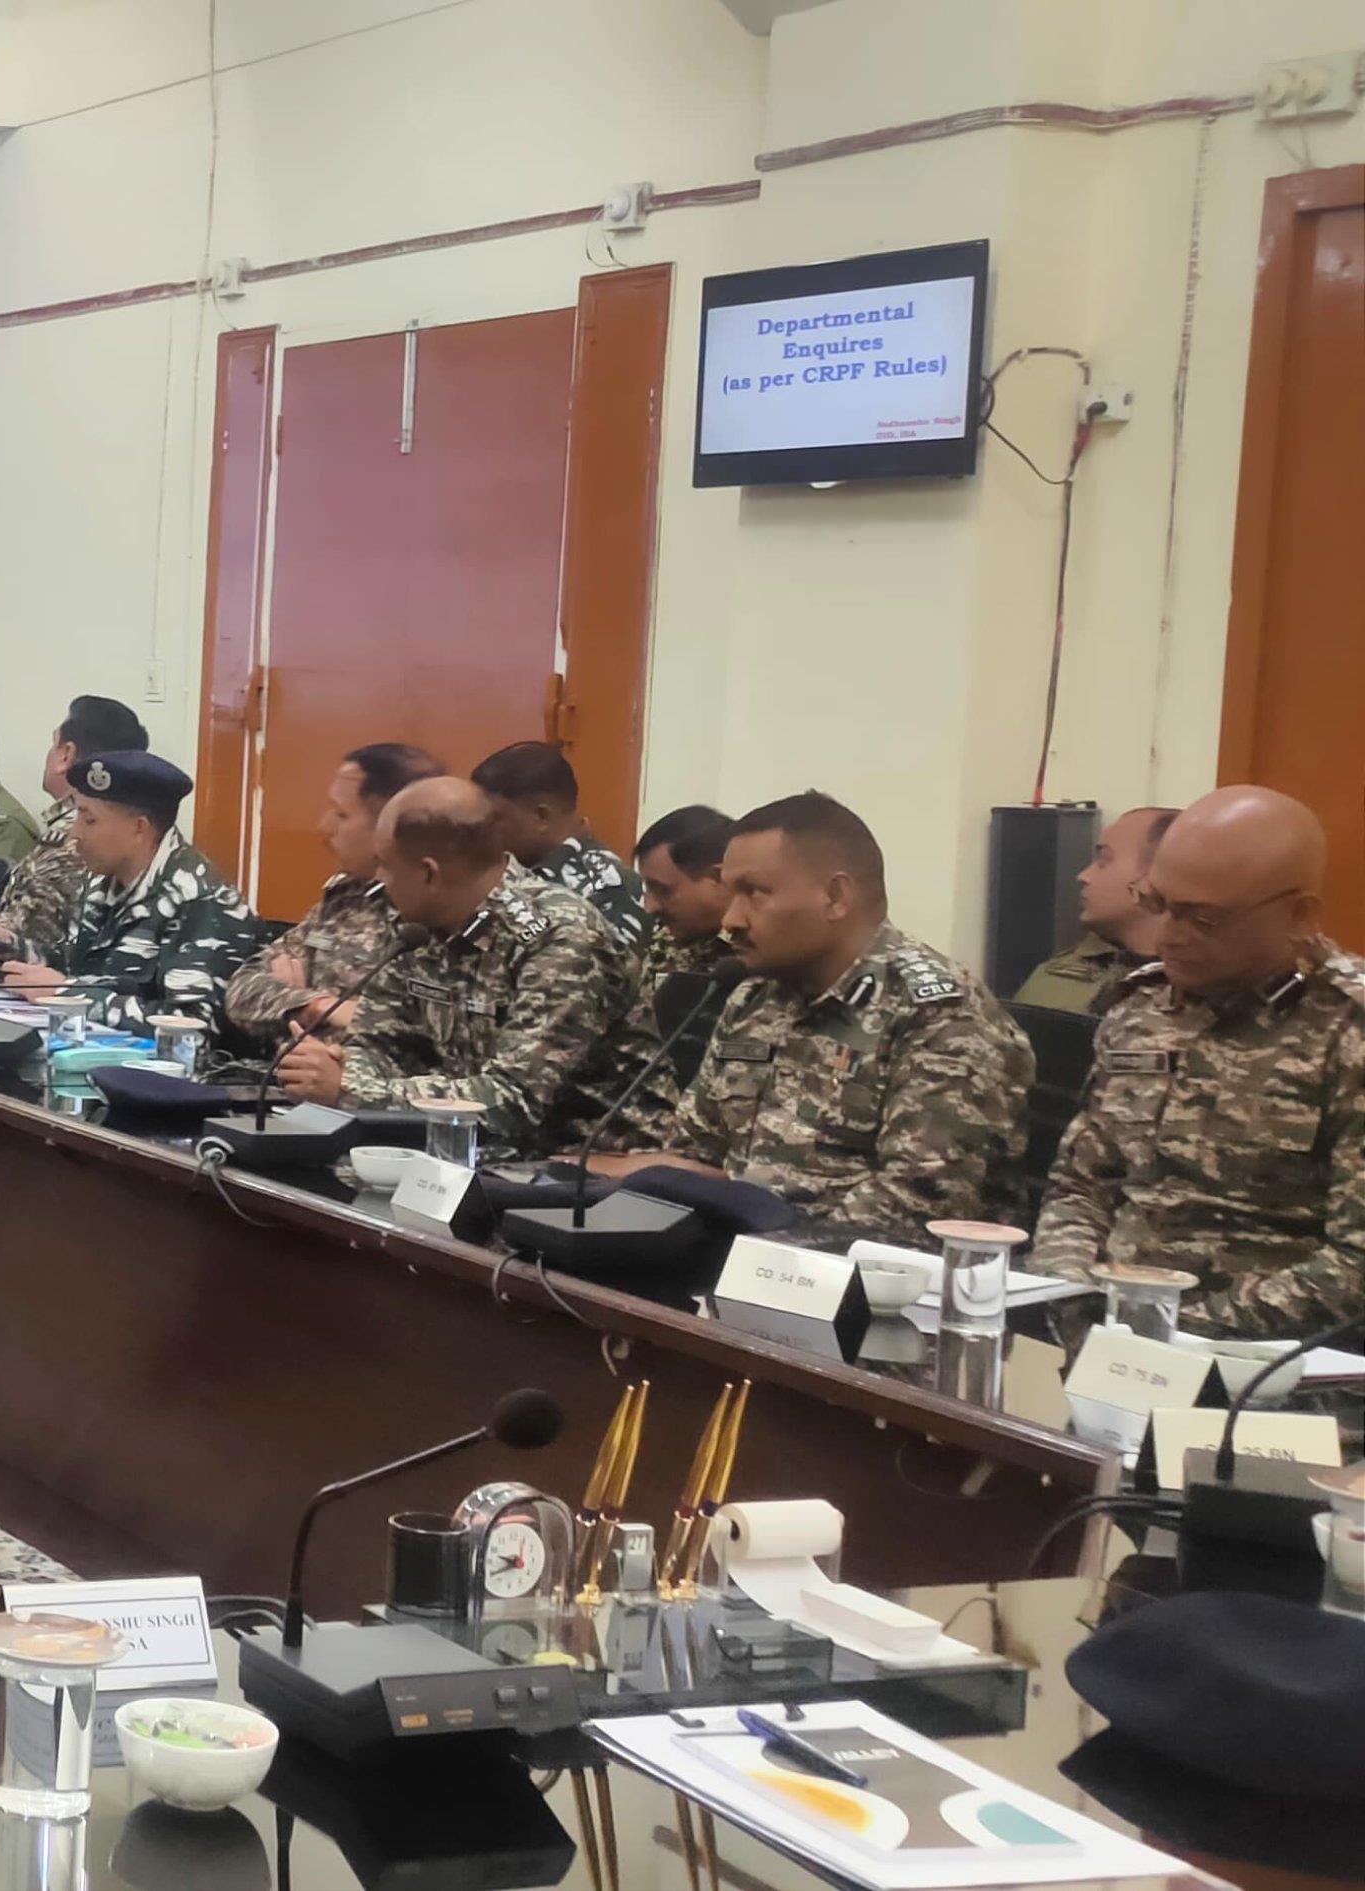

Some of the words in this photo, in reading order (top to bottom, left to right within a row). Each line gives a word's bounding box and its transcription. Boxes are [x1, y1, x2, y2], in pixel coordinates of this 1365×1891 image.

[757, 301, 915, 337] Departmental
[782, 335, 884, 360] Enquires
[723, 374, 751, 395] (as
[759, 371, 795, 392] per
[802, 363, 866, 384] CRPF
[874, 355, 948, 378] Rules)
[918, 982, 955, 998] CRP
[146, 1612, 197, 1630] SINGH
